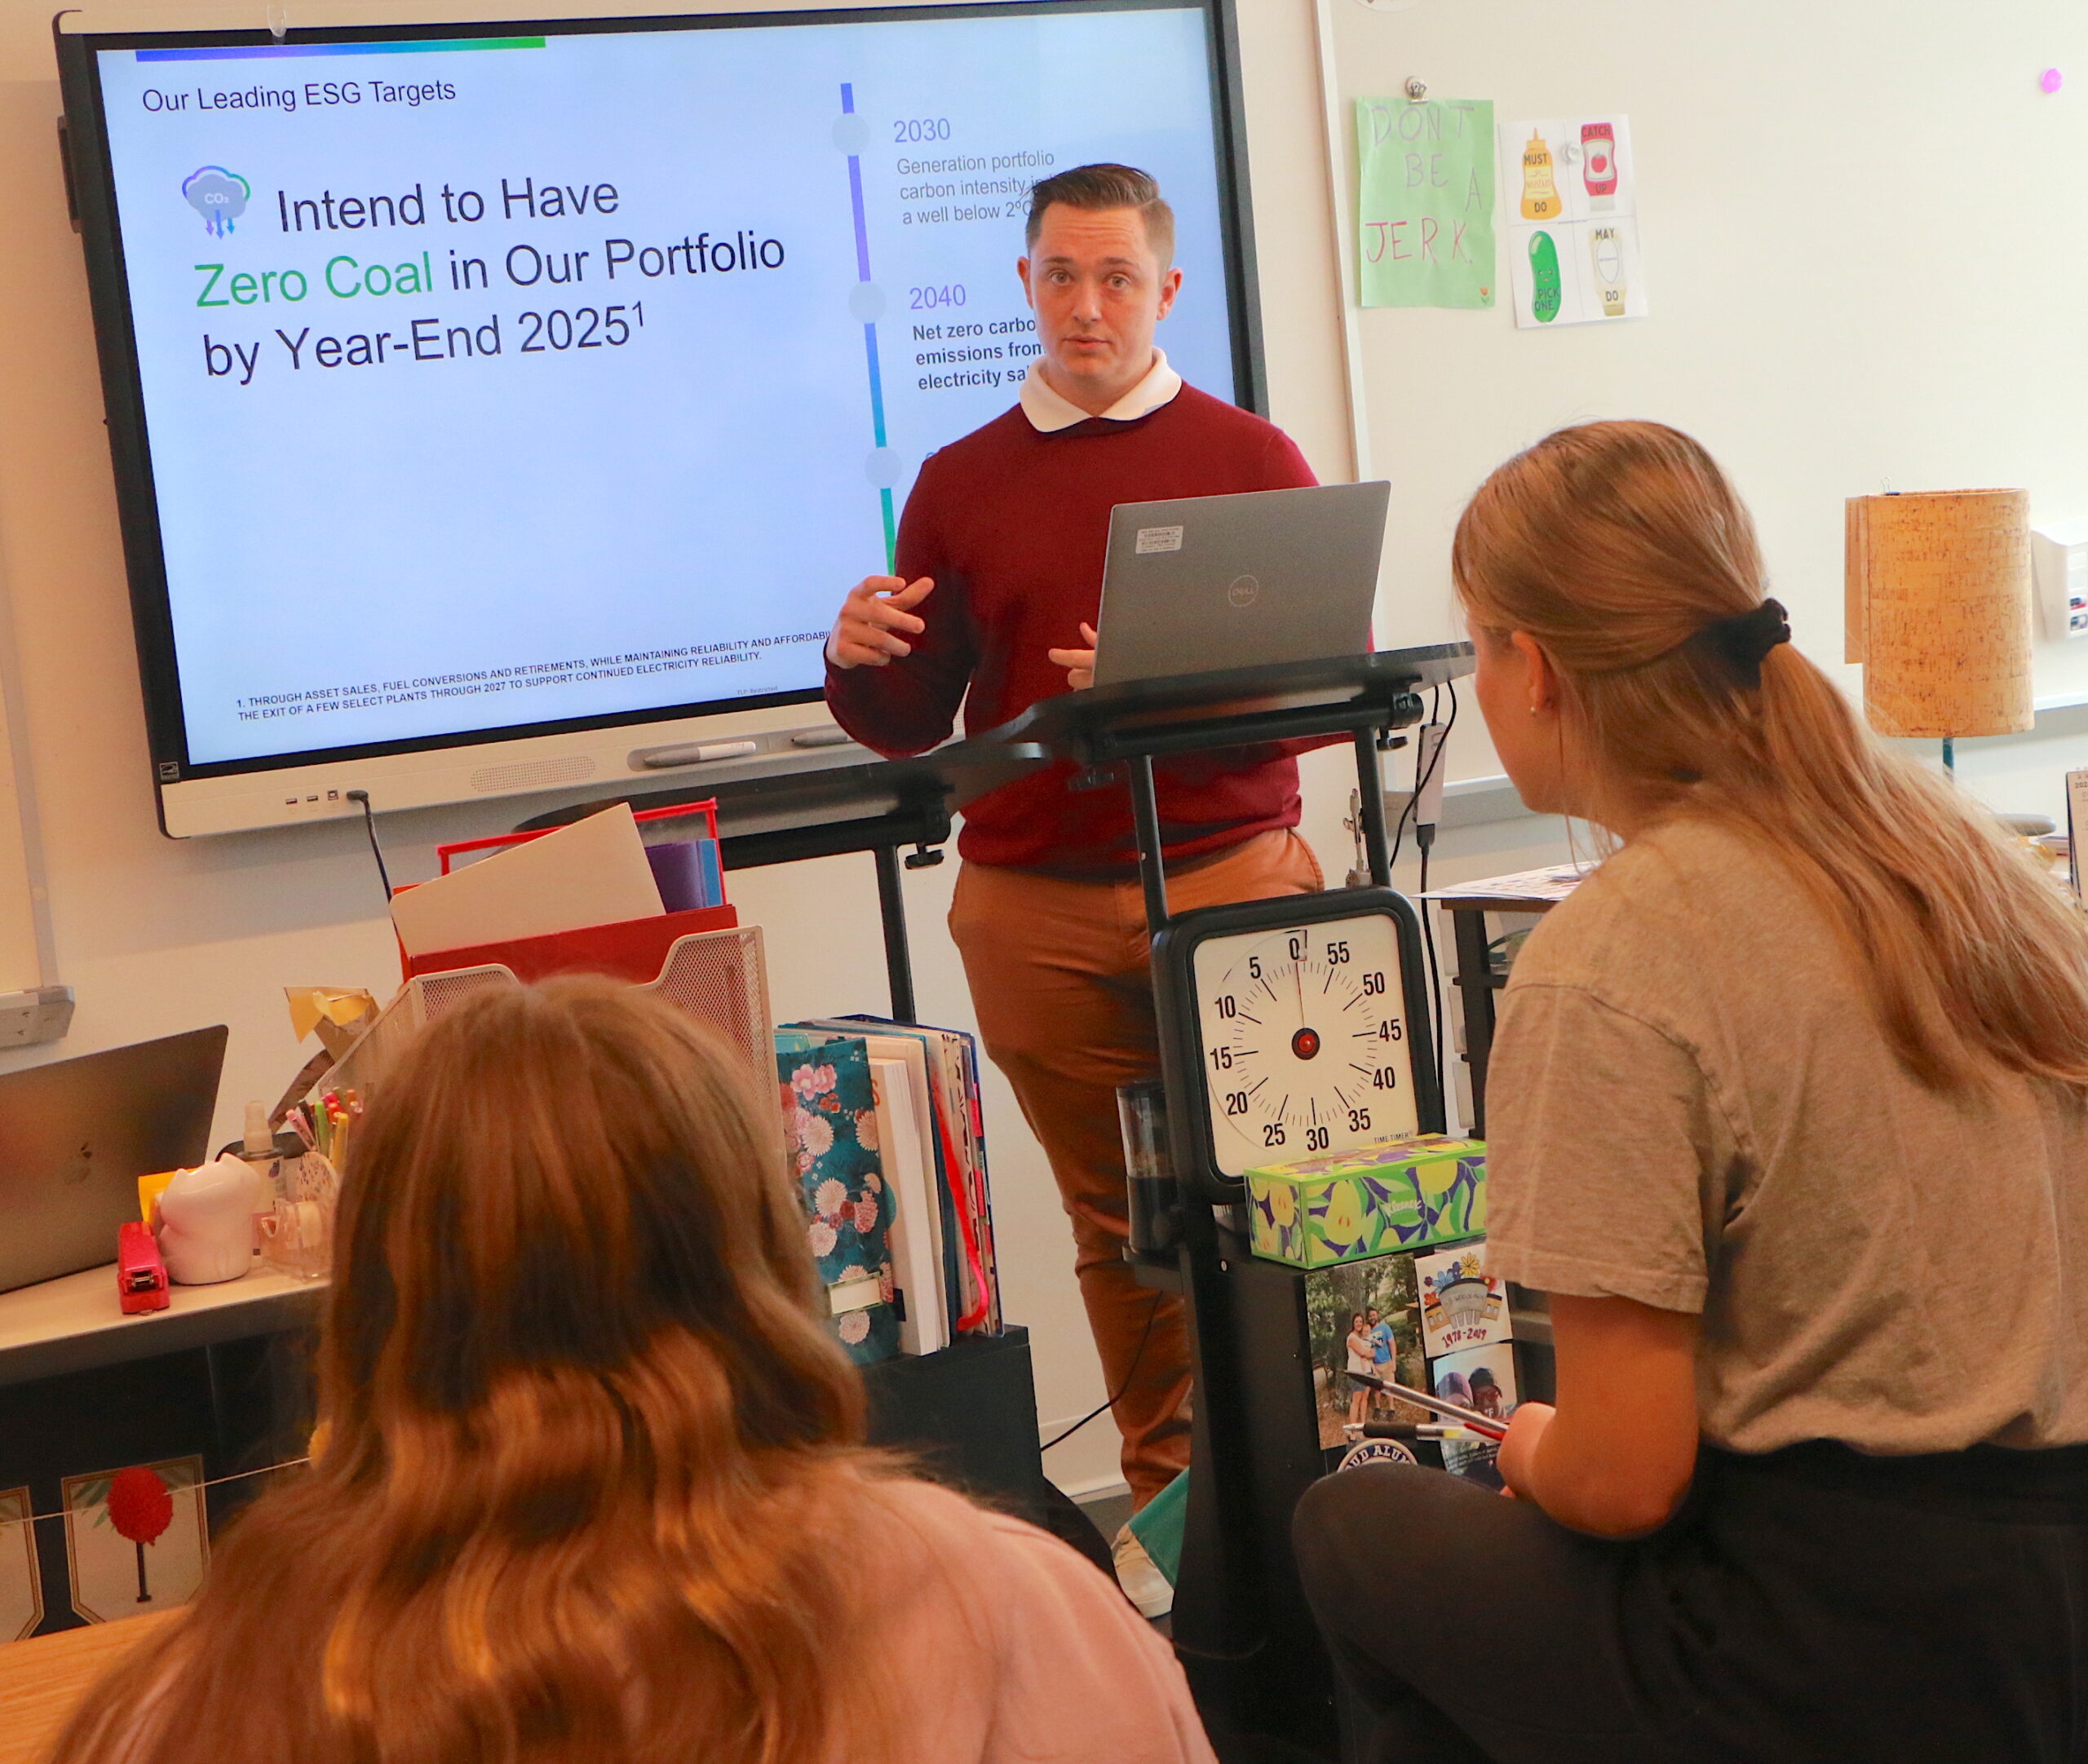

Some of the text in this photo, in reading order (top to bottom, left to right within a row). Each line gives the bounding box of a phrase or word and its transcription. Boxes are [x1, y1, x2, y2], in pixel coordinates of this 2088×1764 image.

[143, 80, 456, 112] Our Leading ESG Targets
[894, 118, 951, 143] 2030
[1581, 126, 1612, 137] CATCH
[897, 150, 1055, 175] Generation portfolio
[1524, 153, 1548, 166] MUST
[900, 182, 955, 200] carbon
[960, 177, 1026, 197] intensity
[1405, 153, 1482, 212] BE A
[1595, 183, 1608, 194] UP
[278, 177, 619, 232] Intend to Have
[902, 212, 913, 224] a
[918, 206, 949, 223] well
[954, 205, 1000, 221] below
[1534, 201, 1547, 213] DO
[1595, 228, 1615, 240] MAY
[194, 230, 785, 307] Zero Coal in Our Portfolio
[909, 285, 966, 310] 2040
[1537, 287, 1560, 299] PICK
[1605, 290, 1619, 302] DO
[1534, 299, 1555, 312] ONE
[913, 317, 1036, 341] Net zero carbo
[204, 334, 259, 386] by
[275, 314, 501, 369] Year-End
[916, 347, 1002, 365] emissions
[918, 366, 1031, 390] electricity sa
[237, 699, 246, 708] 1.
[249, 692, 302, 707] THROUGH
[305, 687, 339, 701] ASSET
[342, 683, 381, 696] SALES,
[383, 680, 410, 692] FUEL
[412, 671, 488, 688] CONVERSIONS
[490, 668, 511, 679] AND
[515, 659, 588, 675] RETIREMENTS,
[591, 655, 622, 667] WHILE
[625, 648, 688, 662] MAINTAINING
[691, 640, 749, 655] RELIABILITY
[751, 637, 772, 648] AND
[238, 651, 762, 721] THE EXIT OF A FEW SELECT PLANTS THROUGH 2027 TO SUPPORT CONTINUED ELECTRICITY RELIABILITY.
[1289, 938, 1301, 961] 0
[1326, 941, 1350, 965] 55
[1250, 957, 1262, 979] 5
[1363, 971, 1385, 995] 50
[1214, 995, 1236, 1019] 10
[1379, 1019, 1402, 1041] 45
[1210, 1046, 1232, 1070] 15
[1373, 1067, 1396, 1090] 40
[1226, 1091, 1248, 1115] 20
[1348, 1108, 1371, 1132] 35
[1263, 1123, 1285, 1147] 25
[1307, 1127, 1329, 1151] 30
[1374, 1135, 1389, 1144] TIME
[1386, 1198, 1422, 1216] Kleenex
